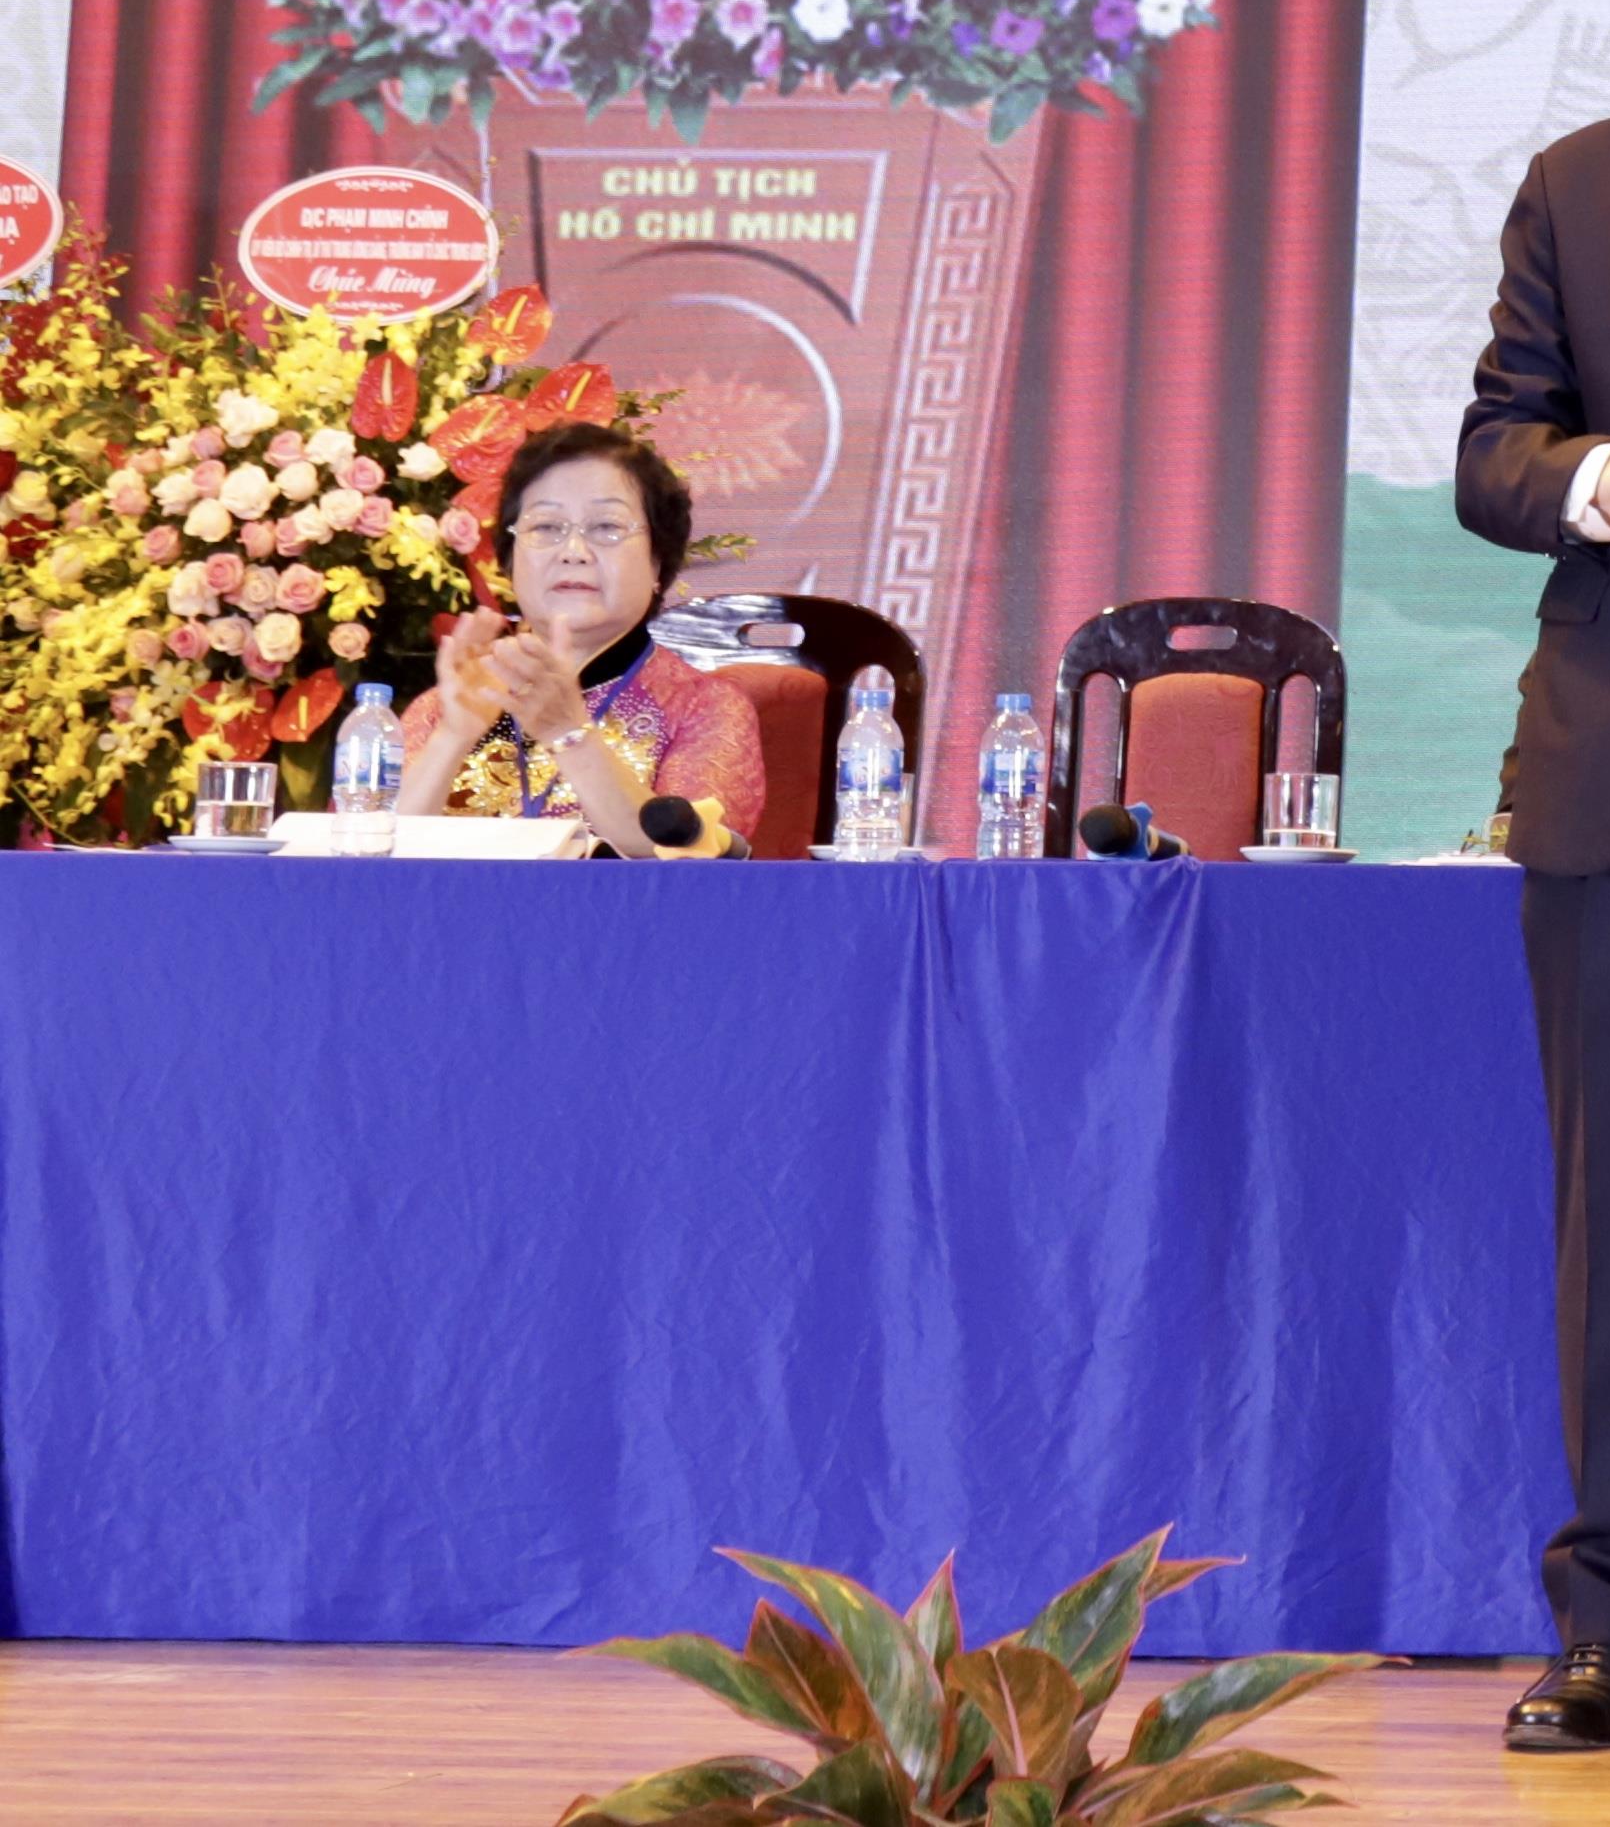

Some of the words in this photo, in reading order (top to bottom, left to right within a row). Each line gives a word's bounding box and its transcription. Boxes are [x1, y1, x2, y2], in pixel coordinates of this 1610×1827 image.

[602, 156, 698, 197] CHỦ
[712, 168, 818, 203] TỊCH
[635, 207, 716, 241] CHÍ
[730, 210, 857, 242] MINH
